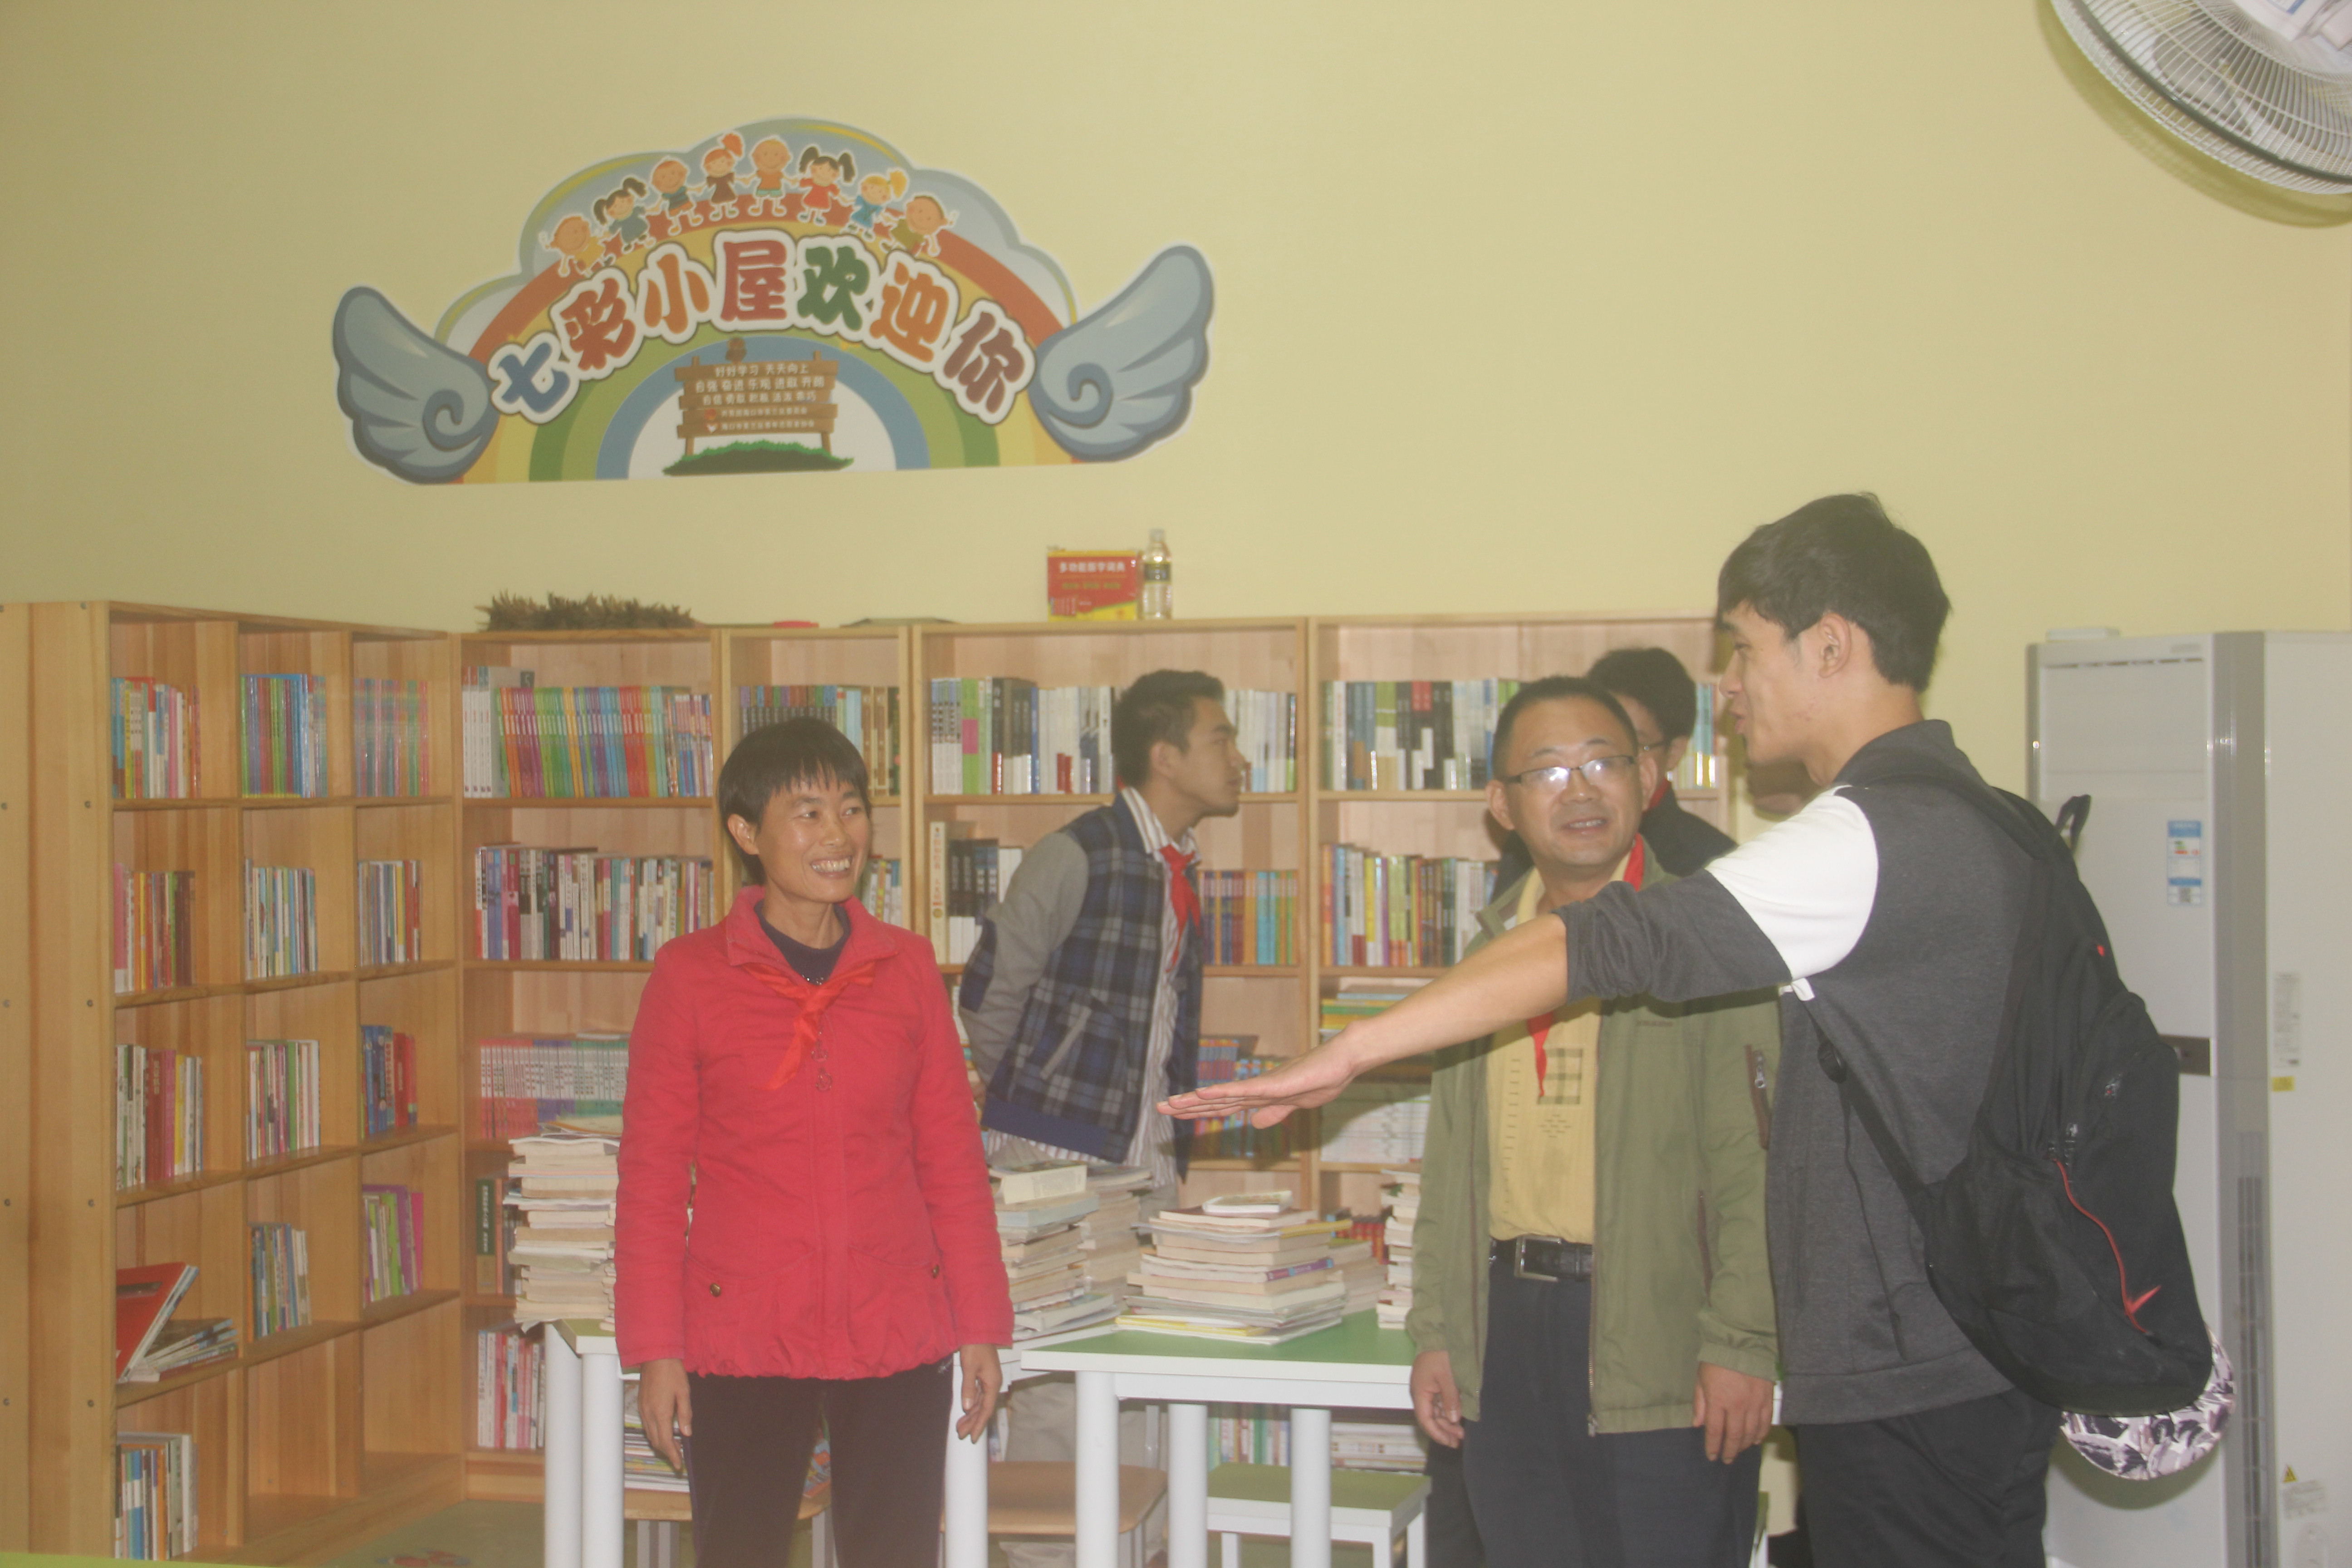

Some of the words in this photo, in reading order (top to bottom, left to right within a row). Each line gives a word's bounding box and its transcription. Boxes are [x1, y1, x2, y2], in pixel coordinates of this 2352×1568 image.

[492, 239, 1028, 415] 七彩小屋欢迎你
[715, 365, 759, 377] 好好学习
[765, 363, 809, 375] 天天向上
[696, 380, 719, 393] 自强
[722, 379, 745, 392] 奋进
[749, 378, 771, 390] 乐观
[775, 376, 798, 390] 进取
[802, 376, 825, 388] 开朗
[704, 394, 722, 406] 自信
